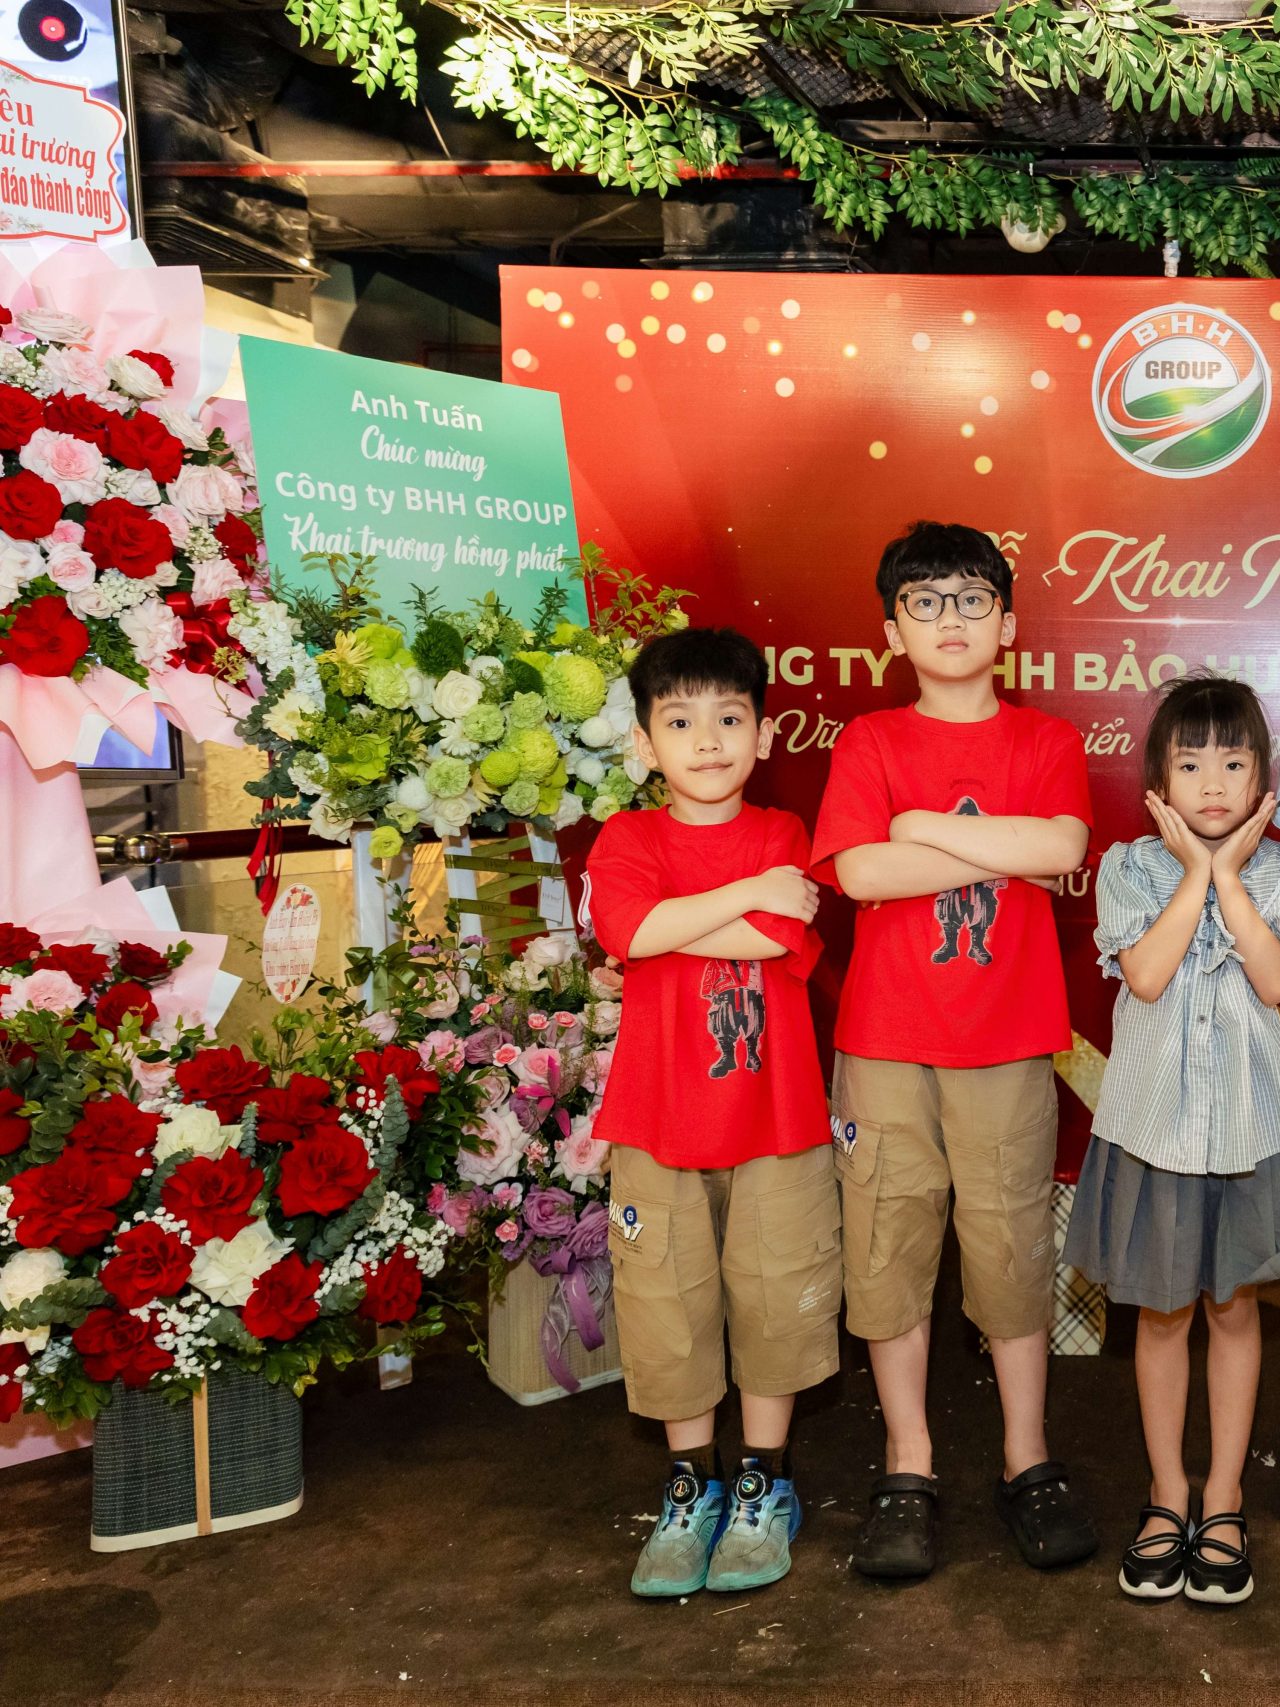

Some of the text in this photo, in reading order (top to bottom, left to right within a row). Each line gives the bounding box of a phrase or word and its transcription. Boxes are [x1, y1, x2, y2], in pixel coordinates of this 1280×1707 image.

[22, 132, 96, 179] trương
[30, 172, 74, 215] thành
[76, 181, 111, 225] công
[1145, 360, 1222, 380] GROUP
[351, 390, 408, 421] Anh
[360, 424, 488, 482] Chúc mừng
[275, 471, 568, 526] Công ty BHH GROUP
[283, 512, 569, 579] Khai trương hồng phát
[1042, 530, 1232, 613] Khai
[829, 648, 894, 687] TY
